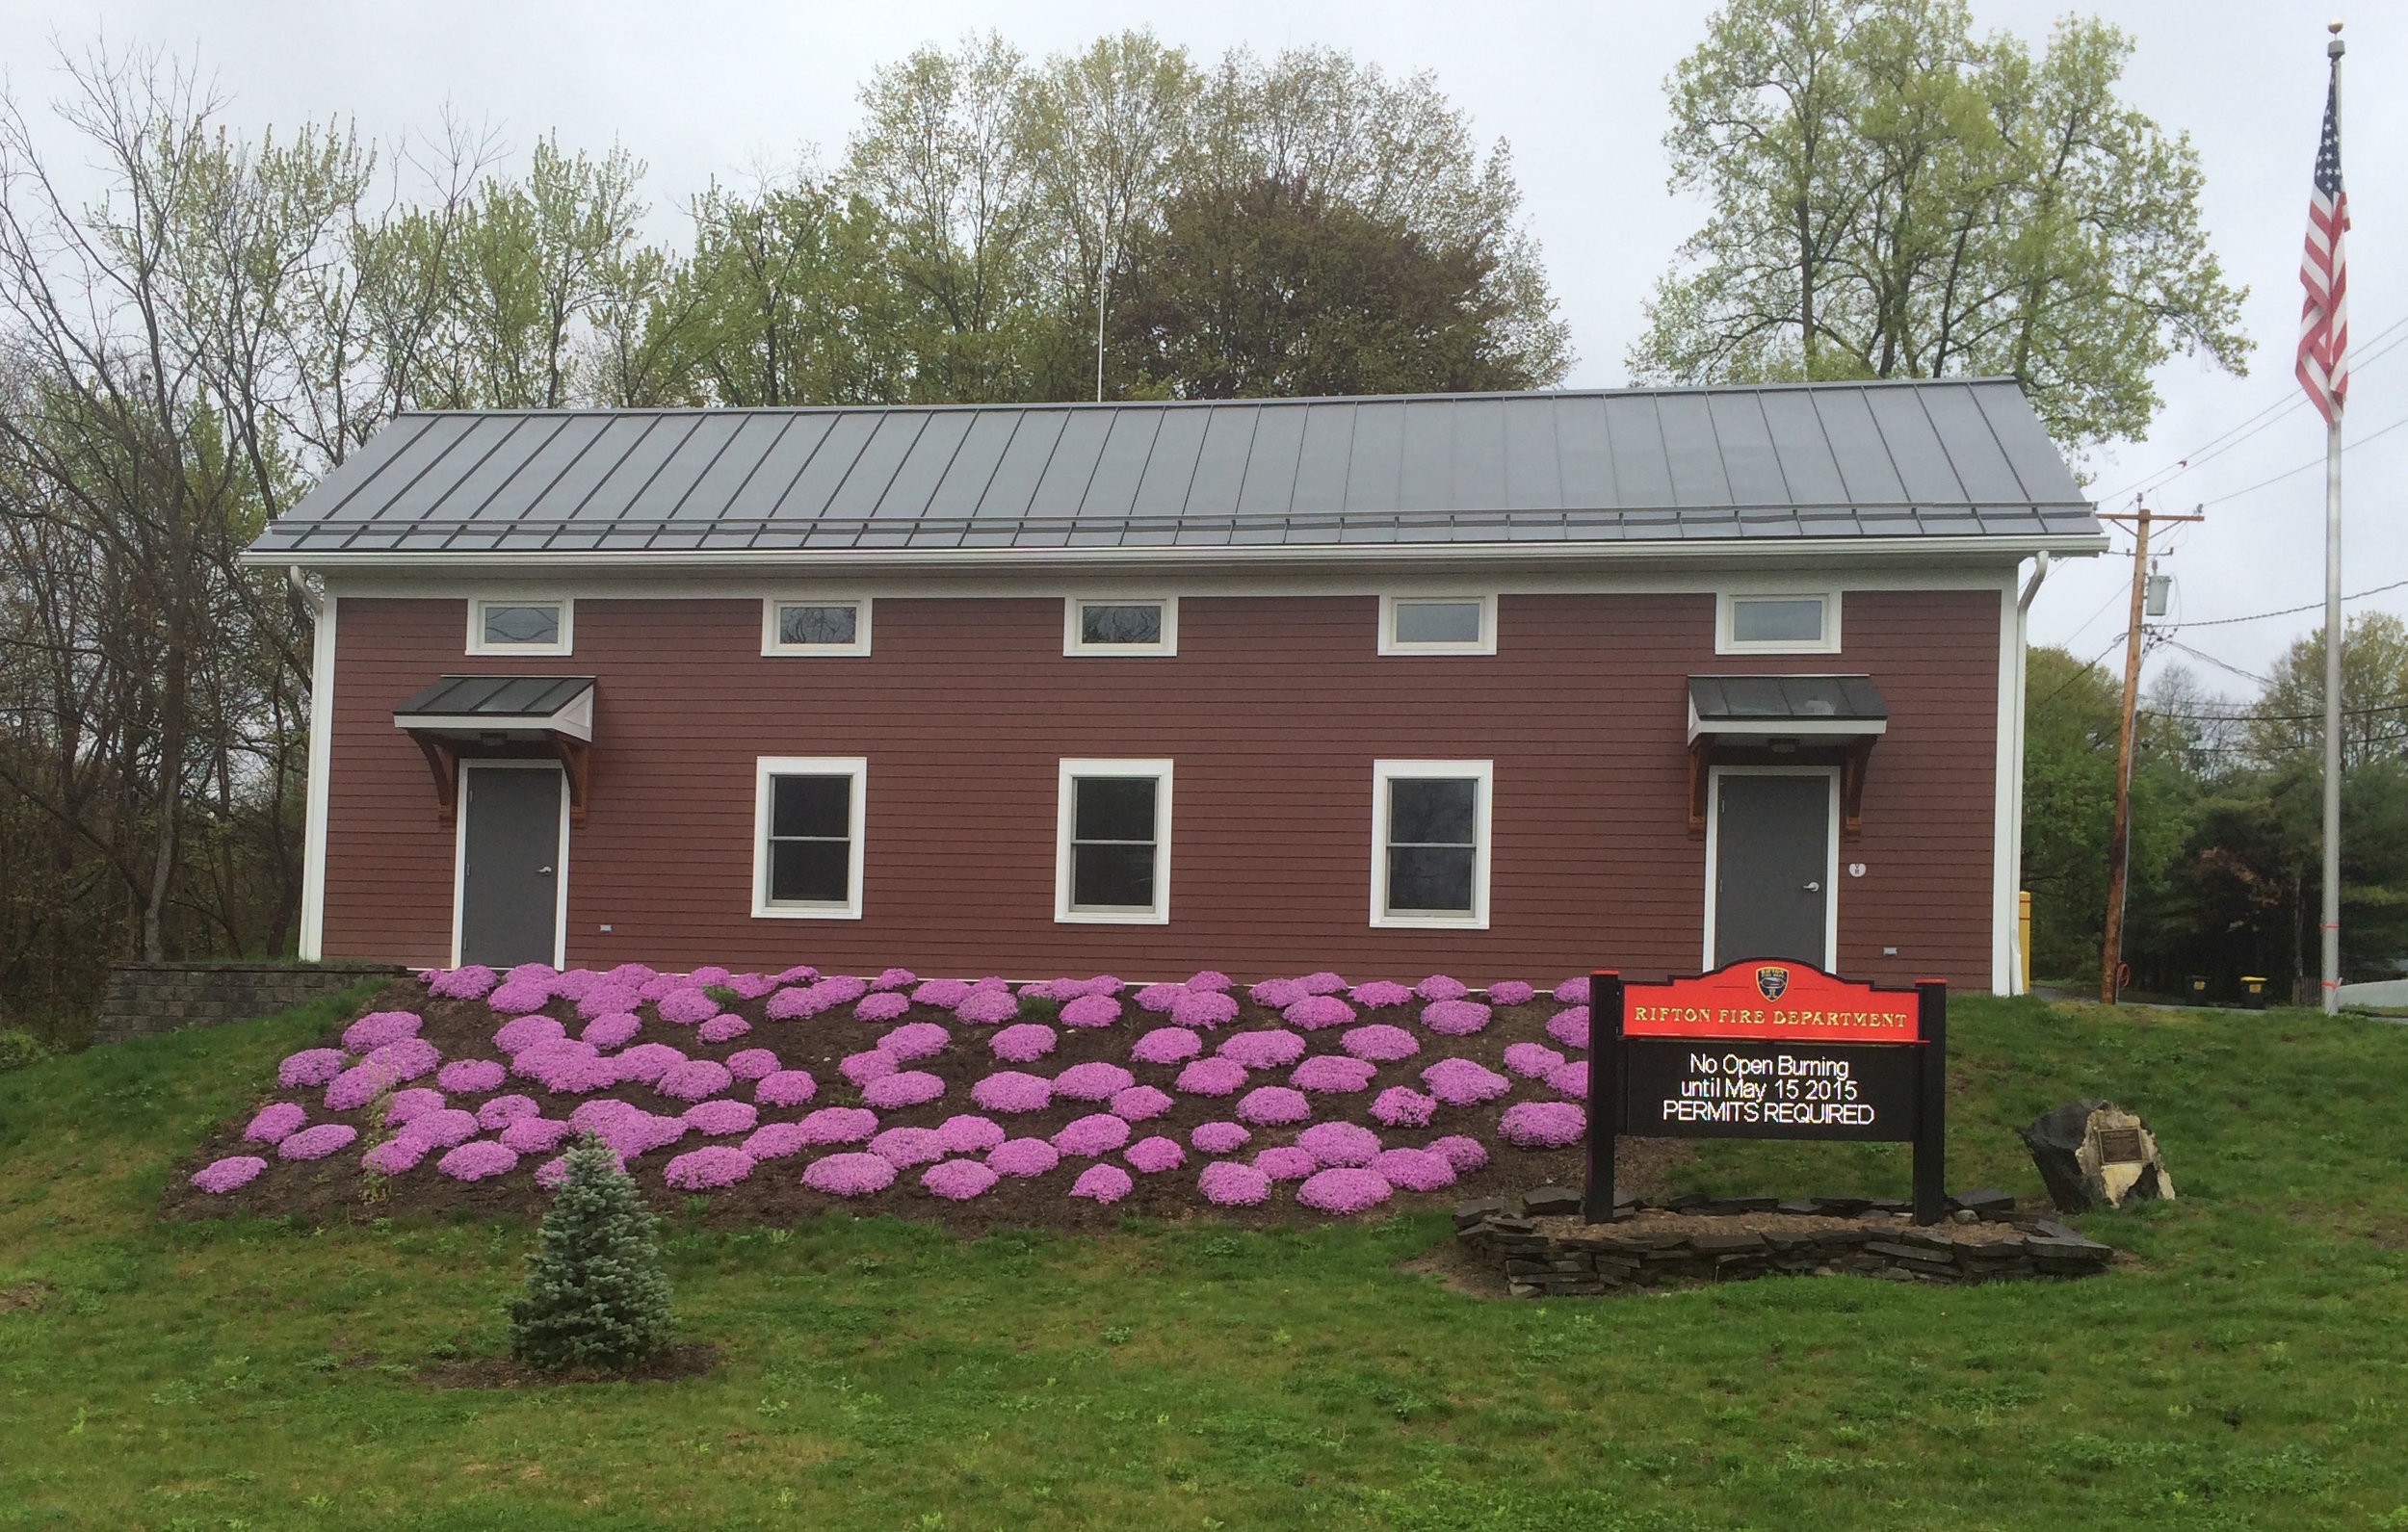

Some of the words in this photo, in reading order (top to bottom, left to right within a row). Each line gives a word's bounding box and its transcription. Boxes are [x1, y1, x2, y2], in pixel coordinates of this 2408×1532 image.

[1635, 1007, 1711, 1022] RIFTON
[1718, 1009, 1765, 1024] FIRE
[1773, 1011, 1907, 1027] DEPARTMENT
[1689, 1052, 1717, 1074] No
[1722, 1053, 1773, 1078] Open
[1778, 1055, 1849, 1081] Burning
[1681, 1078, 1720, 1098] until
[1725, 1078, 1767, 1103] May
[1775, 1079, 1799, 1099] 15
[1805, 1080, 1857, 1101] 2015
[1663, 1101, 1759, 1122] PERMITS
[1764, 1103, 1875, 1125] REQUIRED
